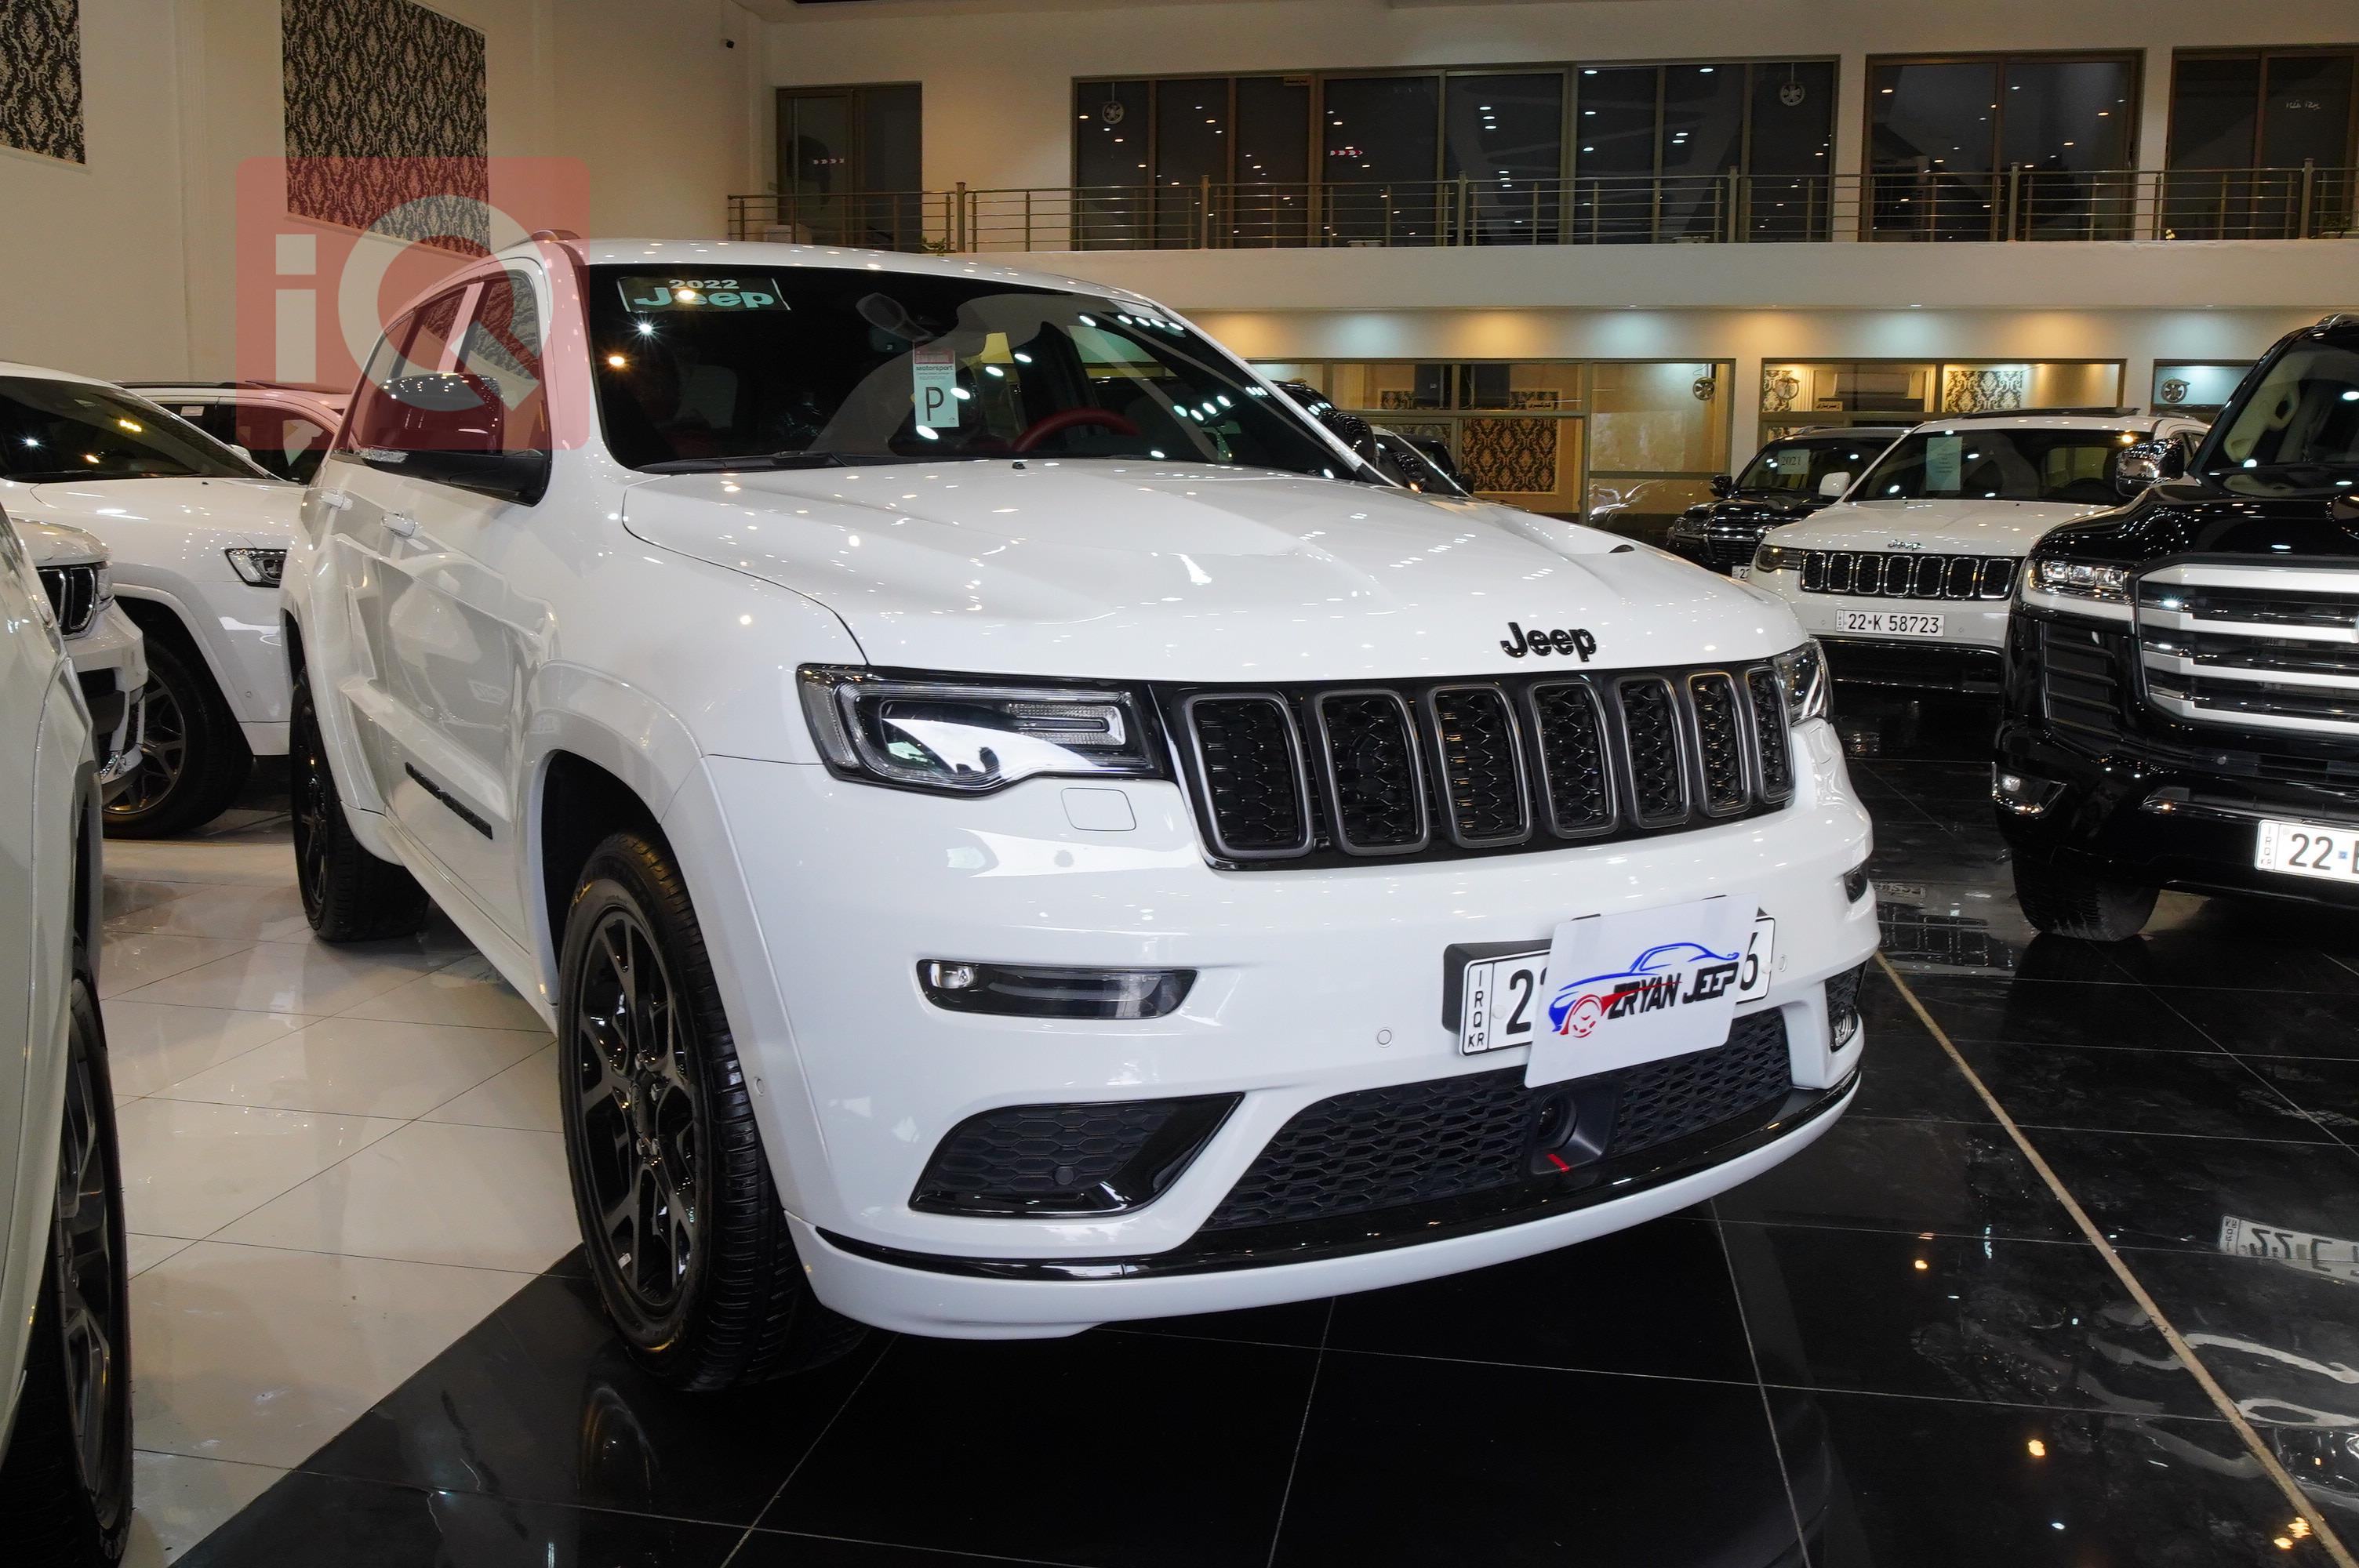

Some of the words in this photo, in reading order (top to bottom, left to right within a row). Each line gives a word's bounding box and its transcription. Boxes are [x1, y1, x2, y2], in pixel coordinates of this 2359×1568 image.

[668, 279, 740, 289] 2022
[634, 288, 774, 308] Jeep
[925, 387, 944, 421] P
[1888, 615, 1939, 633] 58723
[1499, 622, 1597, 662] Jeep
[1682, 961, 1739, 1004] JEEP
[1506, 966, 1548, 1036] 2
[1467, 1032, 1485, 1048] KR
